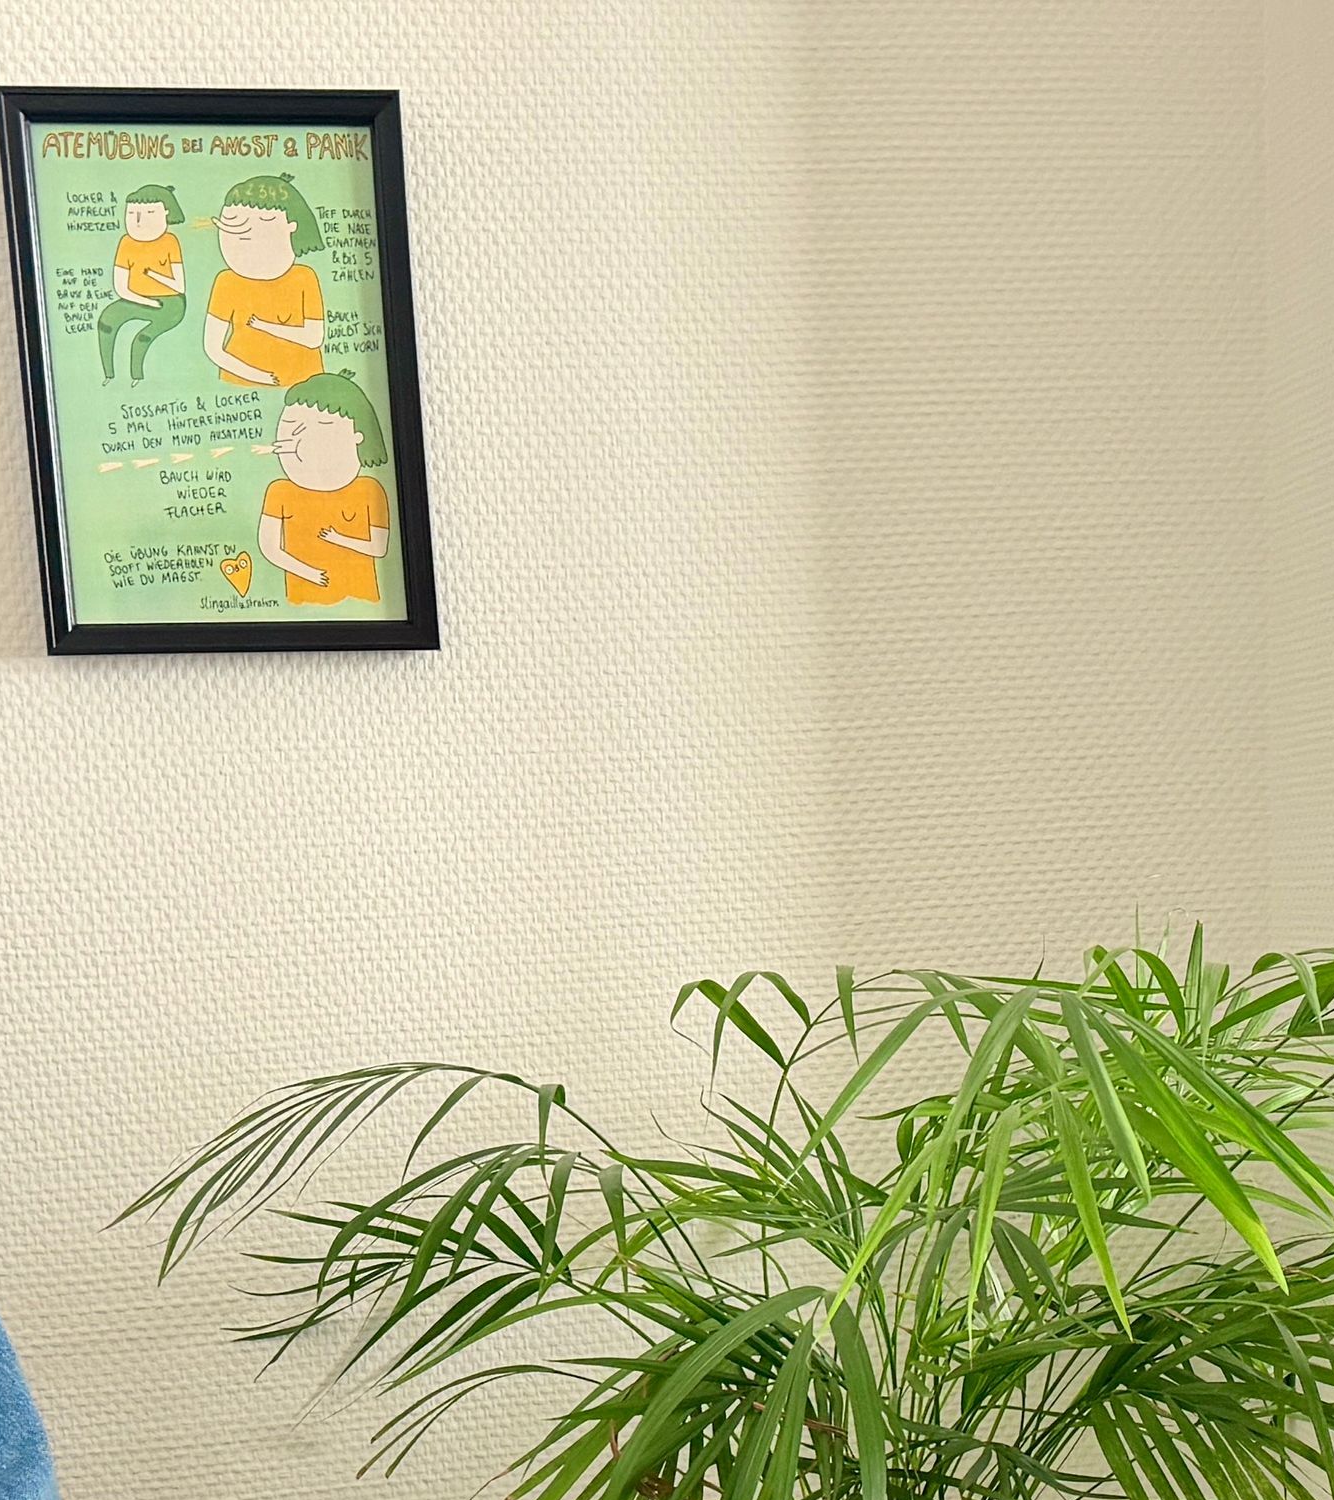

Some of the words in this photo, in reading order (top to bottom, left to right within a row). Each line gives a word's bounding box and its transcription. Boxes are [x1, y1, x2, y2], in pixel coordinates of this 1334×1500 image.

[42, 130, 175, 160] ATEMÜBUNG
[181, 137, 203, 153] BEI
[210, 134, 279, 158] ANGST
[283, 137, 298, 157] &
[66, 191, 104, 204] LOCKER
[110, 191, 118, 204] &
[68, 205, 117, 217] AUFRECHT
[315, 206, 337, 220] TIEF
[342, 208, 371, 219] DURCH
[323, 222, 339, 233] DIE
[348, 223, 371, 235] NASE
[332, 251, 341, 264] &
[365, 252, 373, 265] 5
[81, 267, 104, 276] HAND
[331, 266, 375, 282] ZÄHLEN
[62, 277, 77, 285] AUF
[58, 302, 75, 310] AUF
[79, 302, 98, 312] DEN
[64, 312, 93, 322] BAUCH
[327, 310, 358, 323] BAUCH
[65, 322, 94, 334] LEGEN
[325, 342, 349, 355] NACH
[353, 339, 379, 353] VORN
[196, 396, 207, 411] &
[215, 391, 260, 409] LOCKER
[108, 422, 117, 435] 5
[127, 422, 152, 434] MAL
[102, 440, 135, 454] DURCH
[142, 436, 163, 449] DEN
[172, 434, 201, 446] MUND
[210, 427, 263, 442] AUSATMEN
[159, 470, 199, 485] BAUCH
[163, 502, 227, 519] FLACHER
[130, 545, 168, 560] ÜBUNG
[177, 543, 219, 556] KANNST
[224, 544, 236, 556] DU
[140, 574, 155, 586] DU
